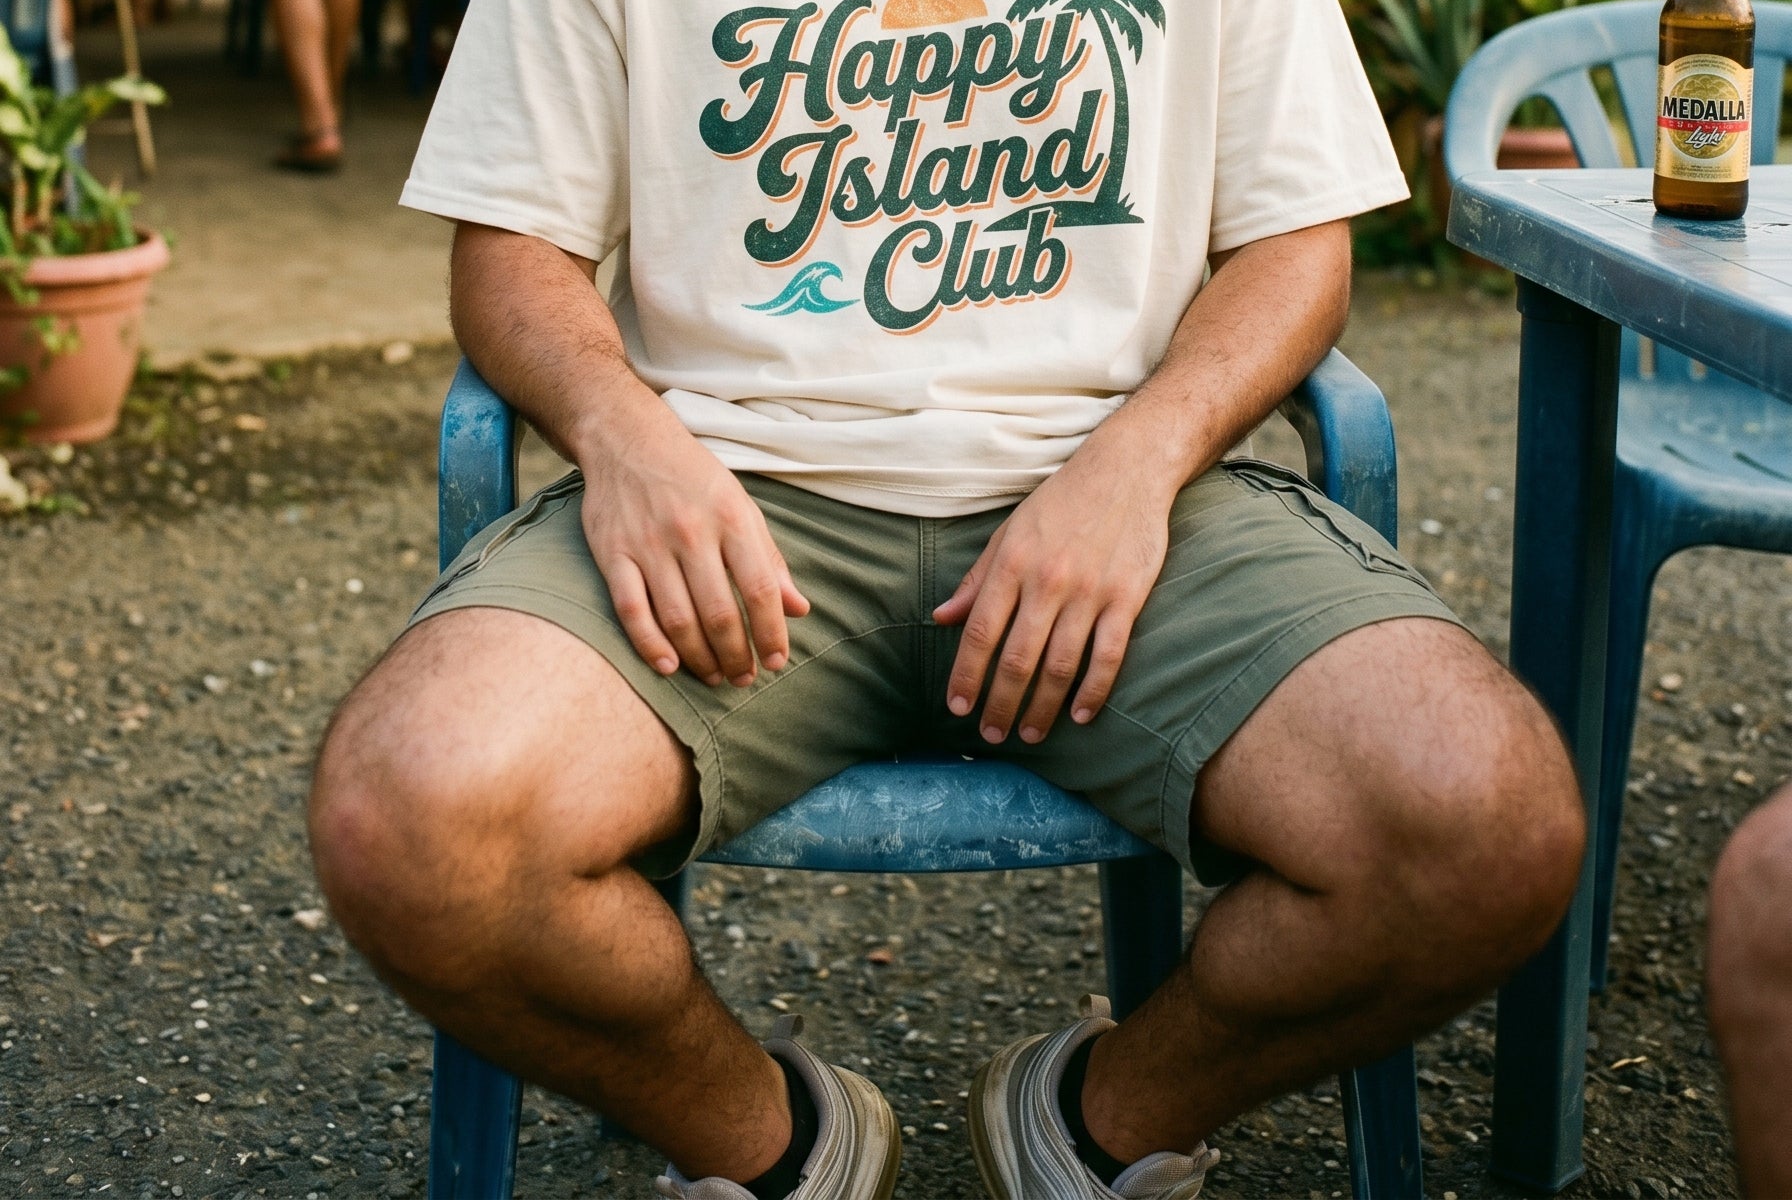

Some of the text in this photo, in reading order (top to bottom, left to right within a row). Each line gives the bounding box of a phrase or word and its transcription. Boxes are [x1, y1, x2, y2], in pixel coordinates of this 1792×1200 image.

[1662, 96, 1746, 121] MEDALLA
[744, 88, 1111, 268] Island
[863, 207, 1073, 336] Club
